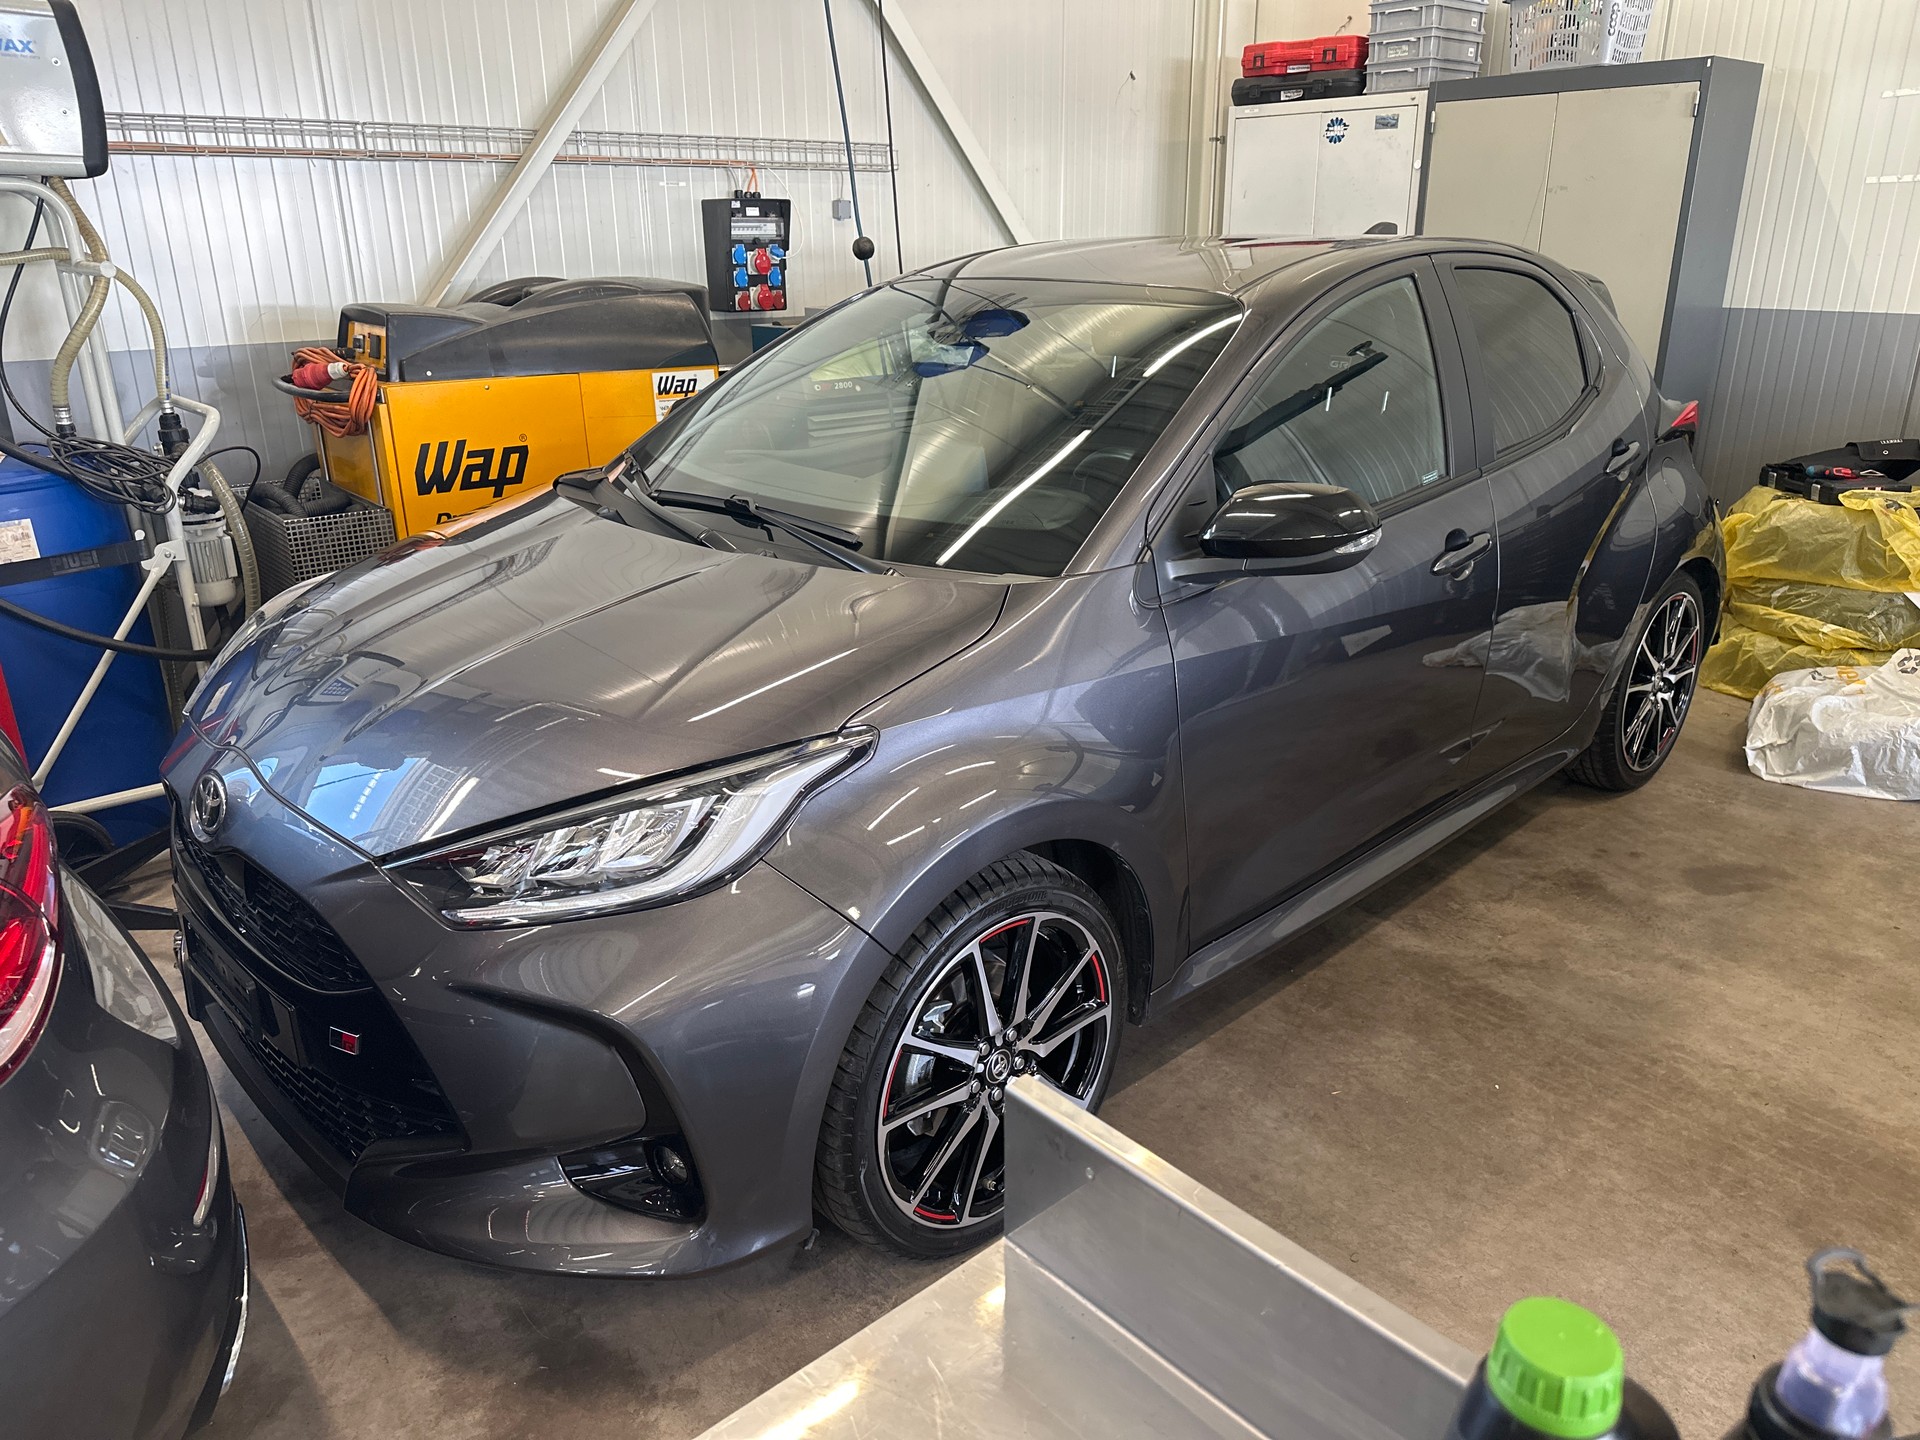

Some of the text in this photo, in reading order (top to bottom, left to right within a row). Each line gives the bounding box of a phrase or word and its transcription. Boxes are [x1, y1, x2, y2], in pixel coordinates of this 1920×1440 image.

[657, 375, 698, 397] Wap
[834, 381, 853, 390] 2800
[415, 440, 529, 498] Wap
